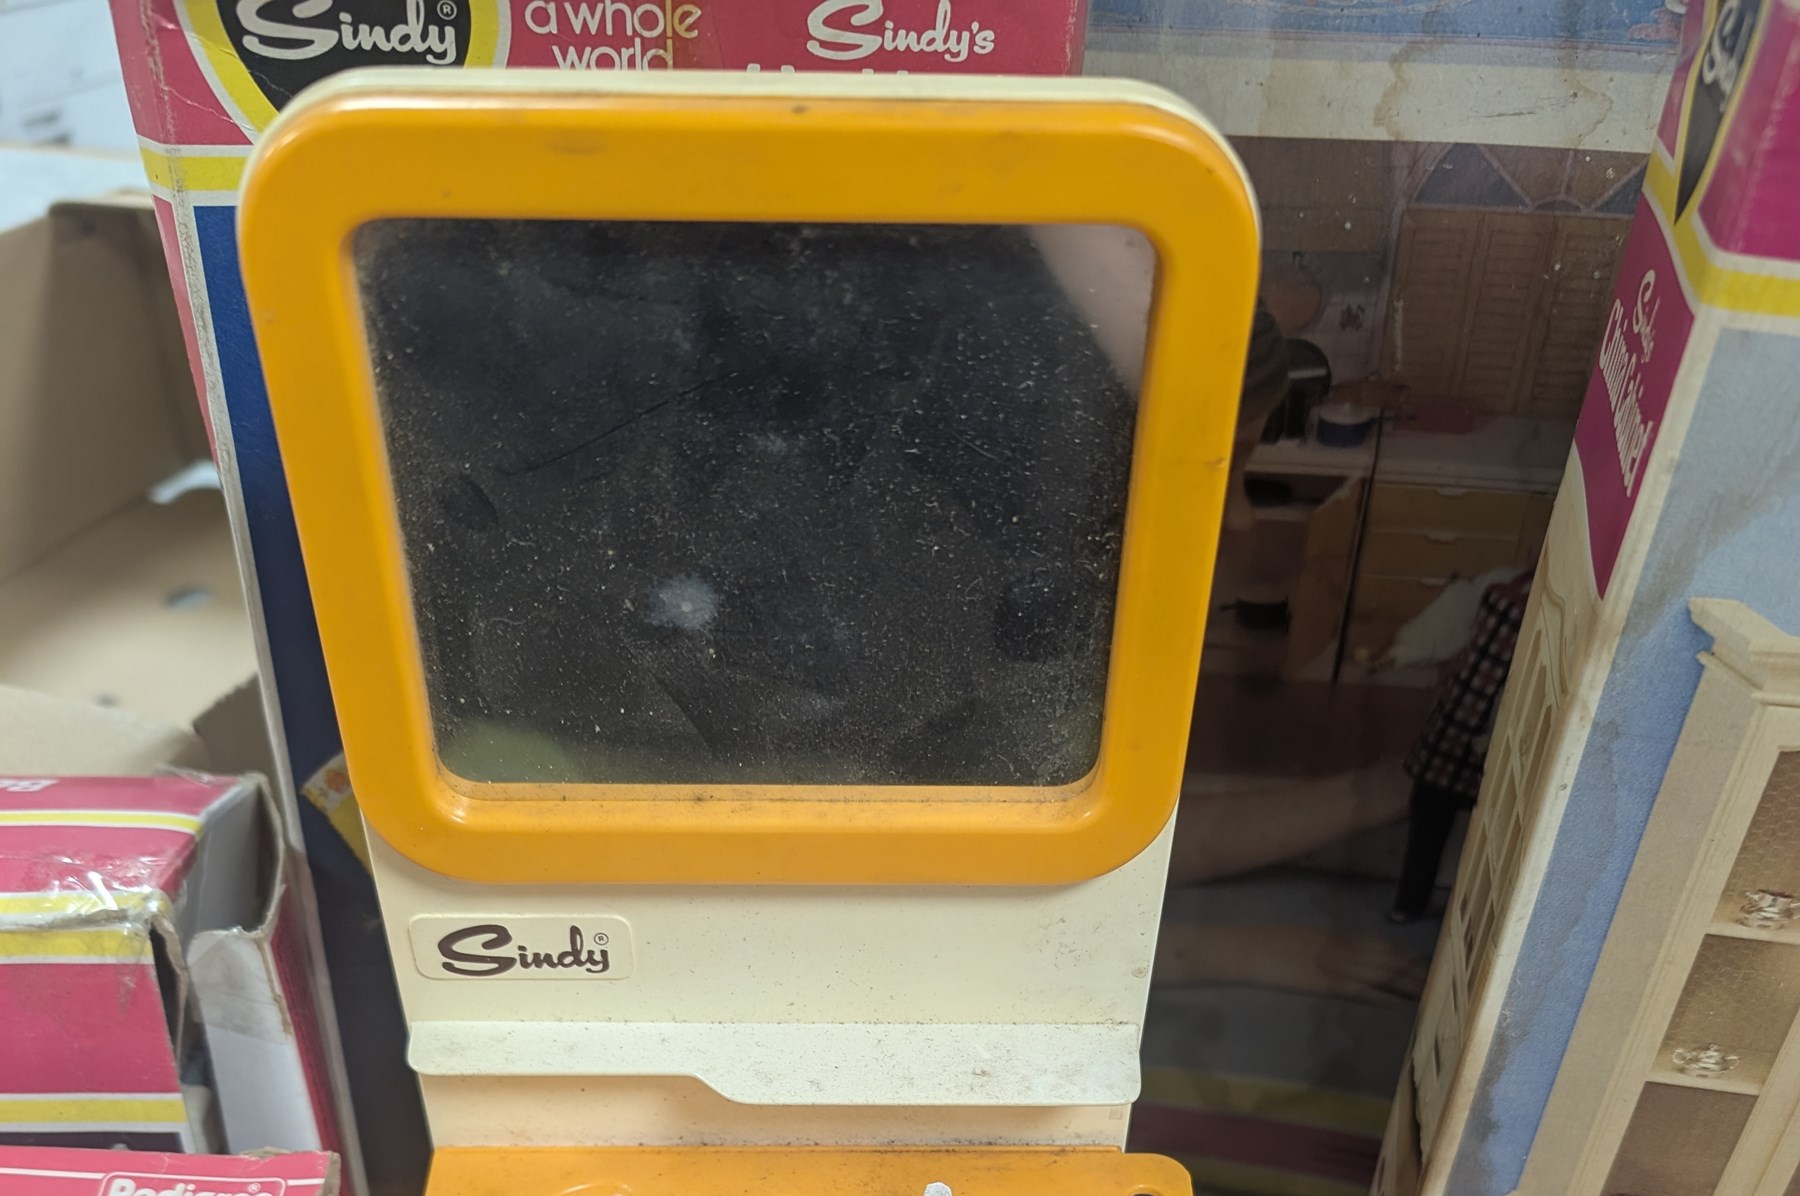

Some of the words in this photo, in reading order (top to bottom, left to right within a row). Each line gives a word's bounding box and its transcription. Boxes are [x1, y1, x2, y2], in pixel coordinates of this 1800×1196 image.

[242, 0, 457, 64] Sindy
[525, 0, 558, 34] a
[564, 0, 702, 39] whole
[806, 0, 996, 63] Sindy's
[552, 37, 674, 71] world
[1599, 298, 1629, 413] China
[1614, 352, 1654, 498] Cabinet
[437, 924, 610, 976] Sindy
